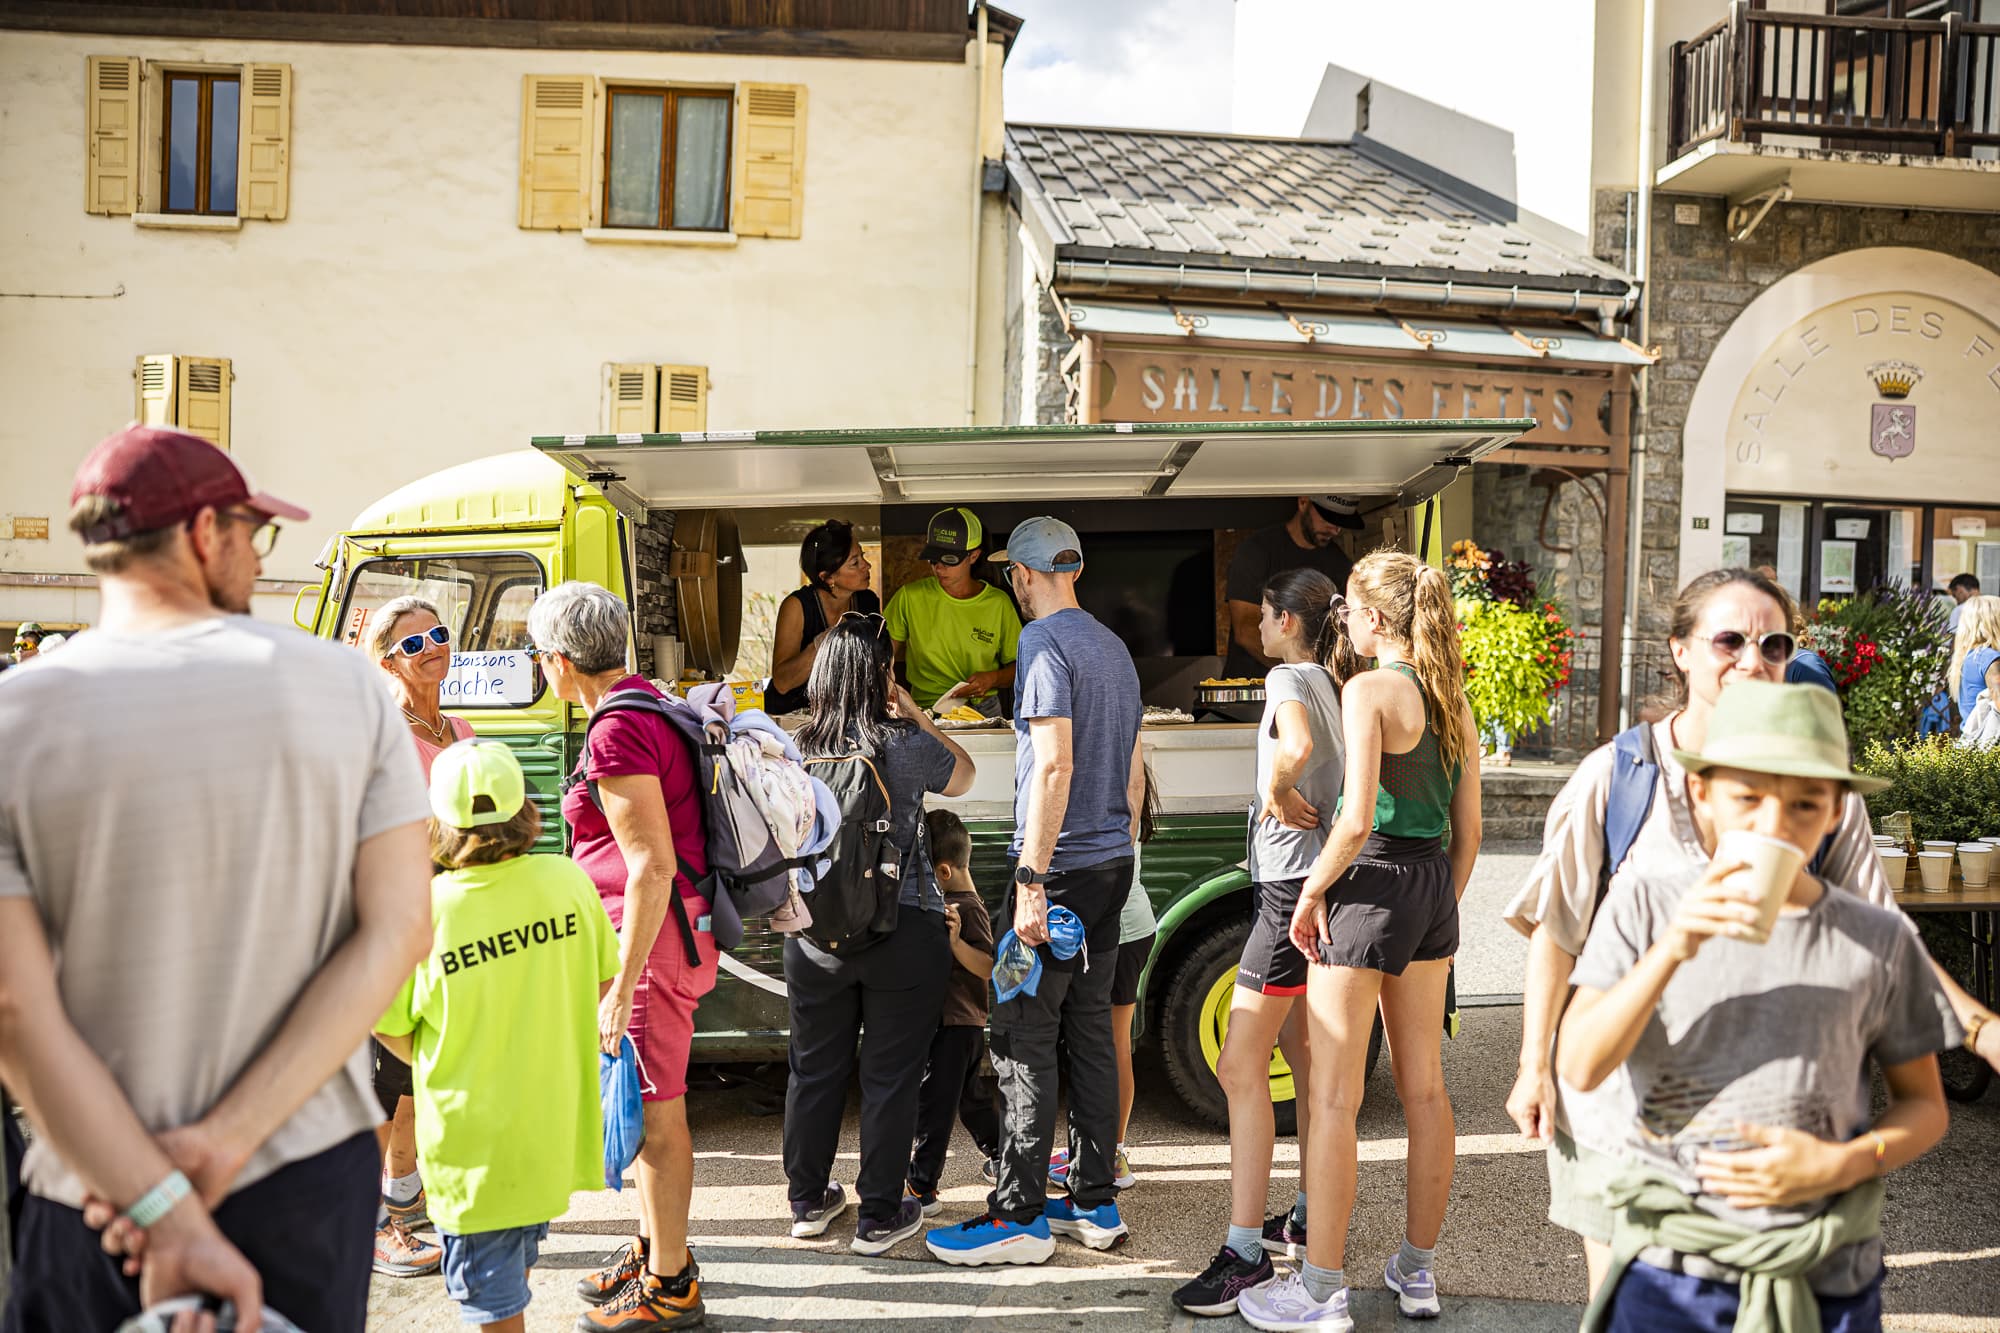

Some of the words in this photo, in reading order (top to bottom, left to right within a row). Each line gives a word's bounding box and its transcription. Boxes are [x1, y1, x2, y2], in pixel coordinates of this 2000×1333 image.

[1142, 364, 1294, 416] SALLE
[1314, 373, 1405, 420] DES
[1735, 325, 1830, 465] SALLE
[1851, 304, 1945, 340] DES
[450, 654, 516, 668] Boissons
[440, 913, 577, 976] BENEVOLE
